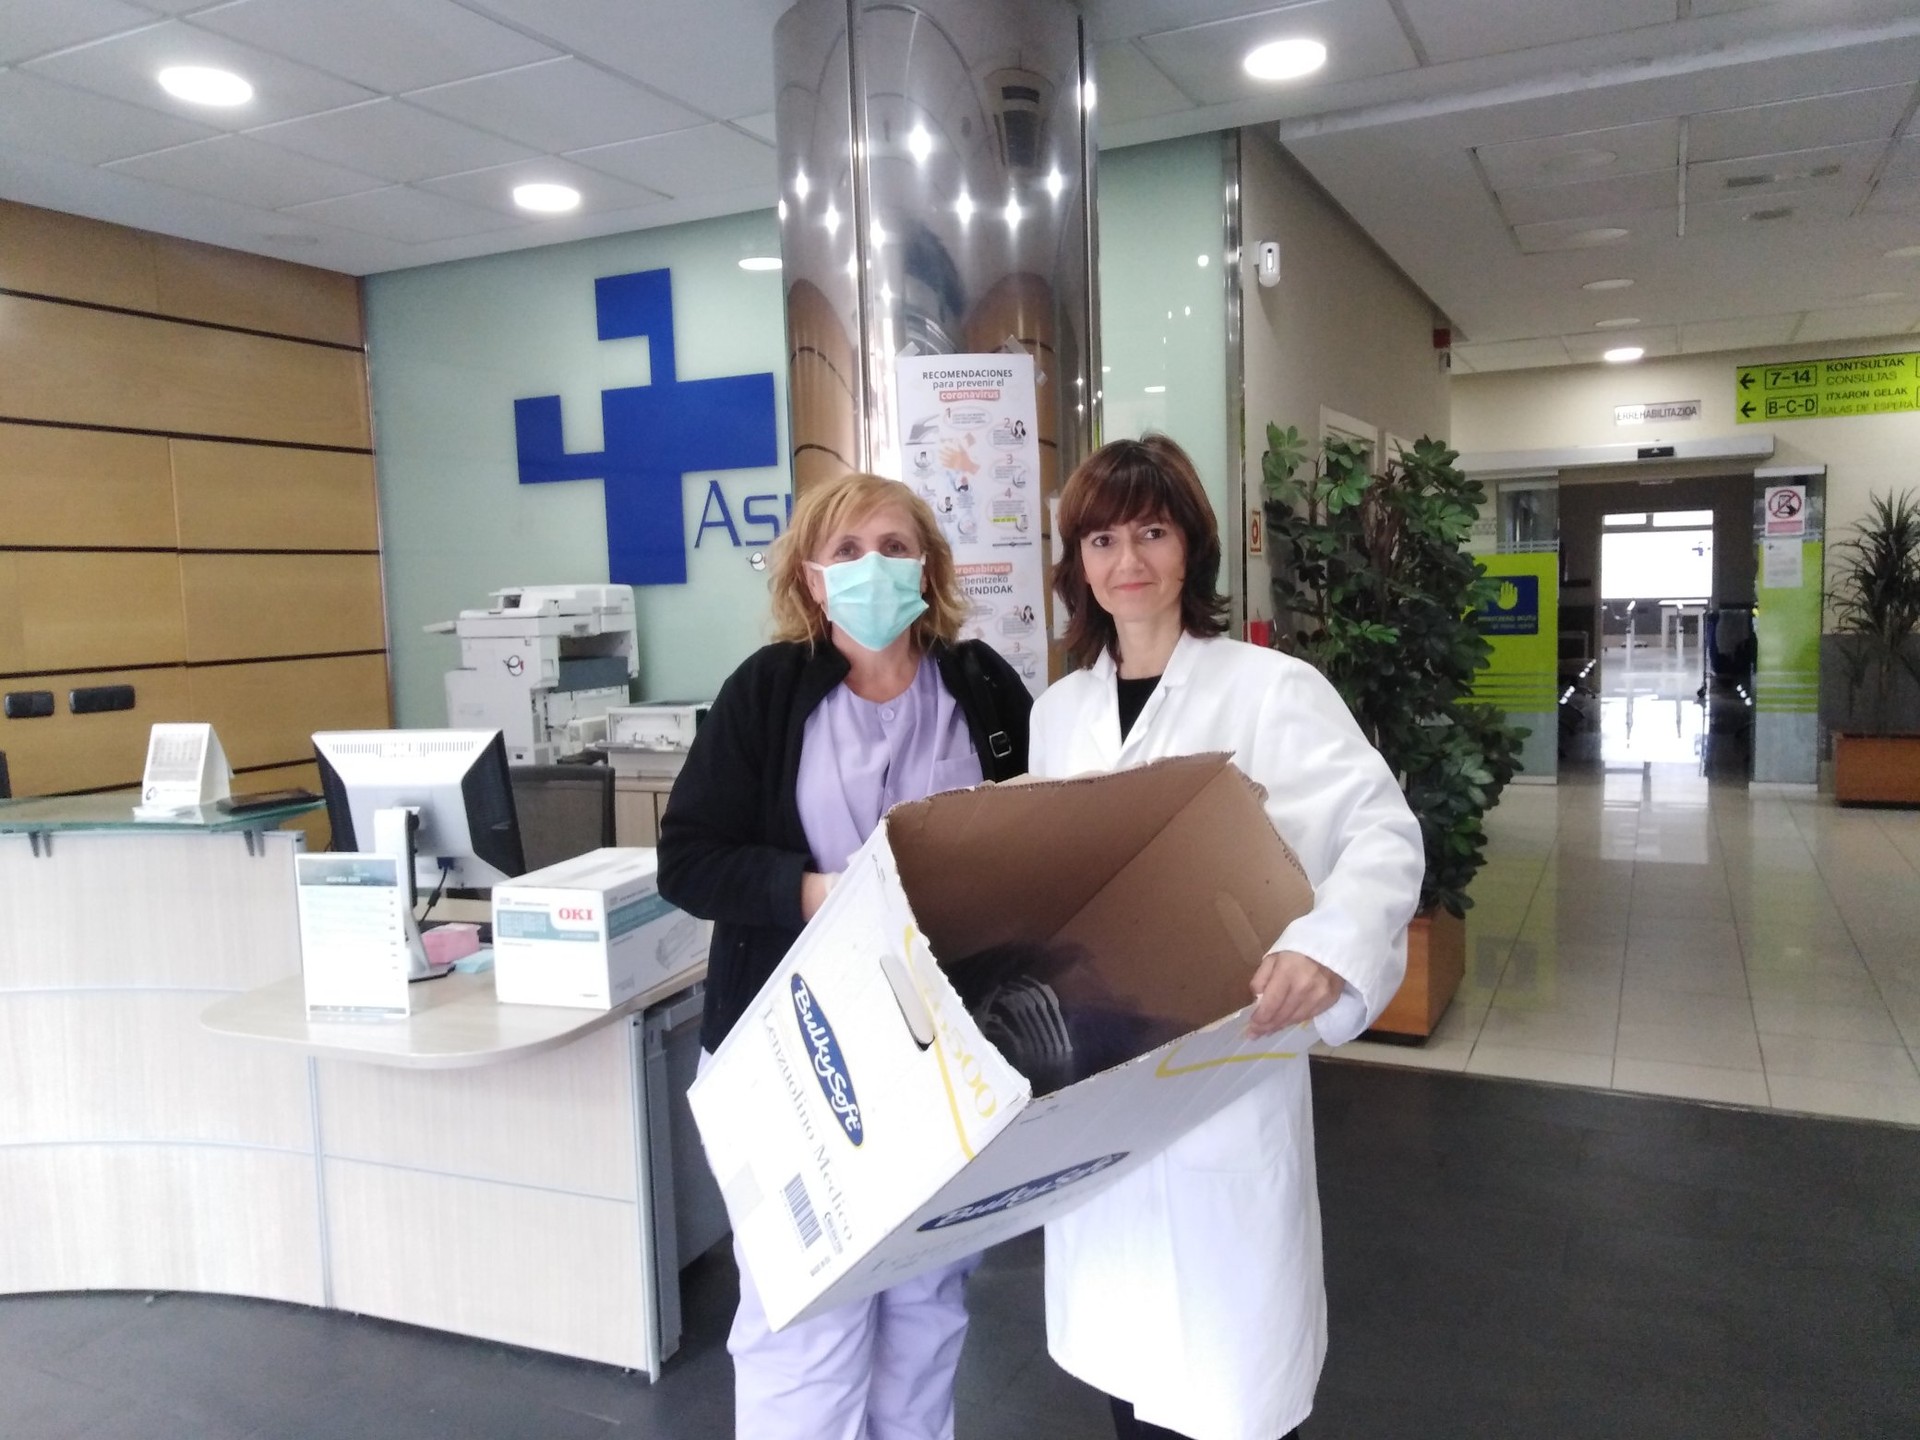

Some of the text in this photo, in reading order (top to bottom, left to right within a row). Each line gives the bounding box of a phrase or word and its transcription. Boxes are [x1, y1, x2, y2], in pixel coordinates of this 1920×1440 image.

[1826, 357, 1905, 373] KONTSULTAK
[922, 369, 1013, 380] RECOMENDACIONES
[1771, 369, 1811, 386] 7-14
[1826, 371, 1897, 386] CONSULTAS
[933, 378, 1005, 390] para prevenir el
[940, 391, 999, 400] coronavirus
[1826, 386, 1908, 401] ITXARON GELAK
[1617, 406, 1698, 421] ERREHABILITAZIOA
[1768, 398, 1816, 415] B-C-D
[1856, 403, 1867, 413] DE
[1874, 400, 1914, 411] ESPERA
[1004, 417, 1011, 429] 2
[1006, 454, 1013, 465] 3
[1004, 487, 1012, 498] 4
[953, 563, 1012, 575] oronabirusa
[558, 907, 594, 921] OKI
[795, 979, 860, 1132] BulkySoft
[761, 1006, 816, 1141] Lenzuolino
[813, 1143, 853, 1241] Medico
